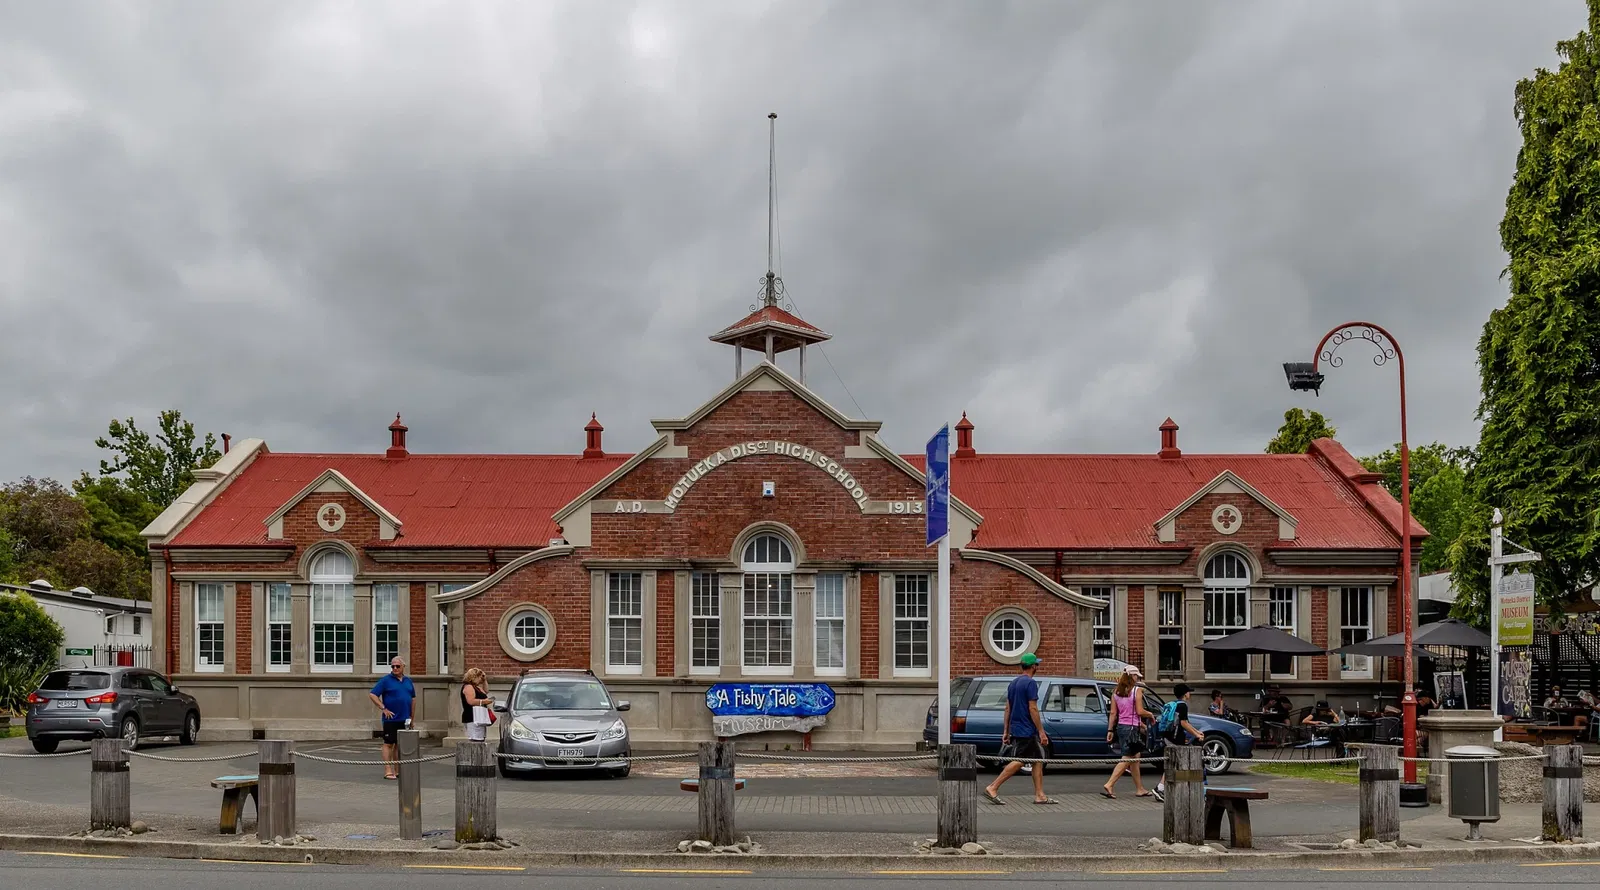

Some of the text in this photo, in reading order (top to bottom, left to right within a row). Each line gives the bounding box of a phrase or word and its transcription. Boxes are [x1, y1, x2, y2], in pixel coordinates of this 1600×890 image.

[664, 451, 727, 510] MOTUEKA
[815, 456, 870, 510] SCHOOL
[615, 501, 647, 513] A.D.
[889, 502, 922, 513] 1913
[1501, 606, 1529, 618] MUSEUM
[716, 688, 797, 710] A Fishy Tale
[720, 718, 791, 732] MUSEUM
